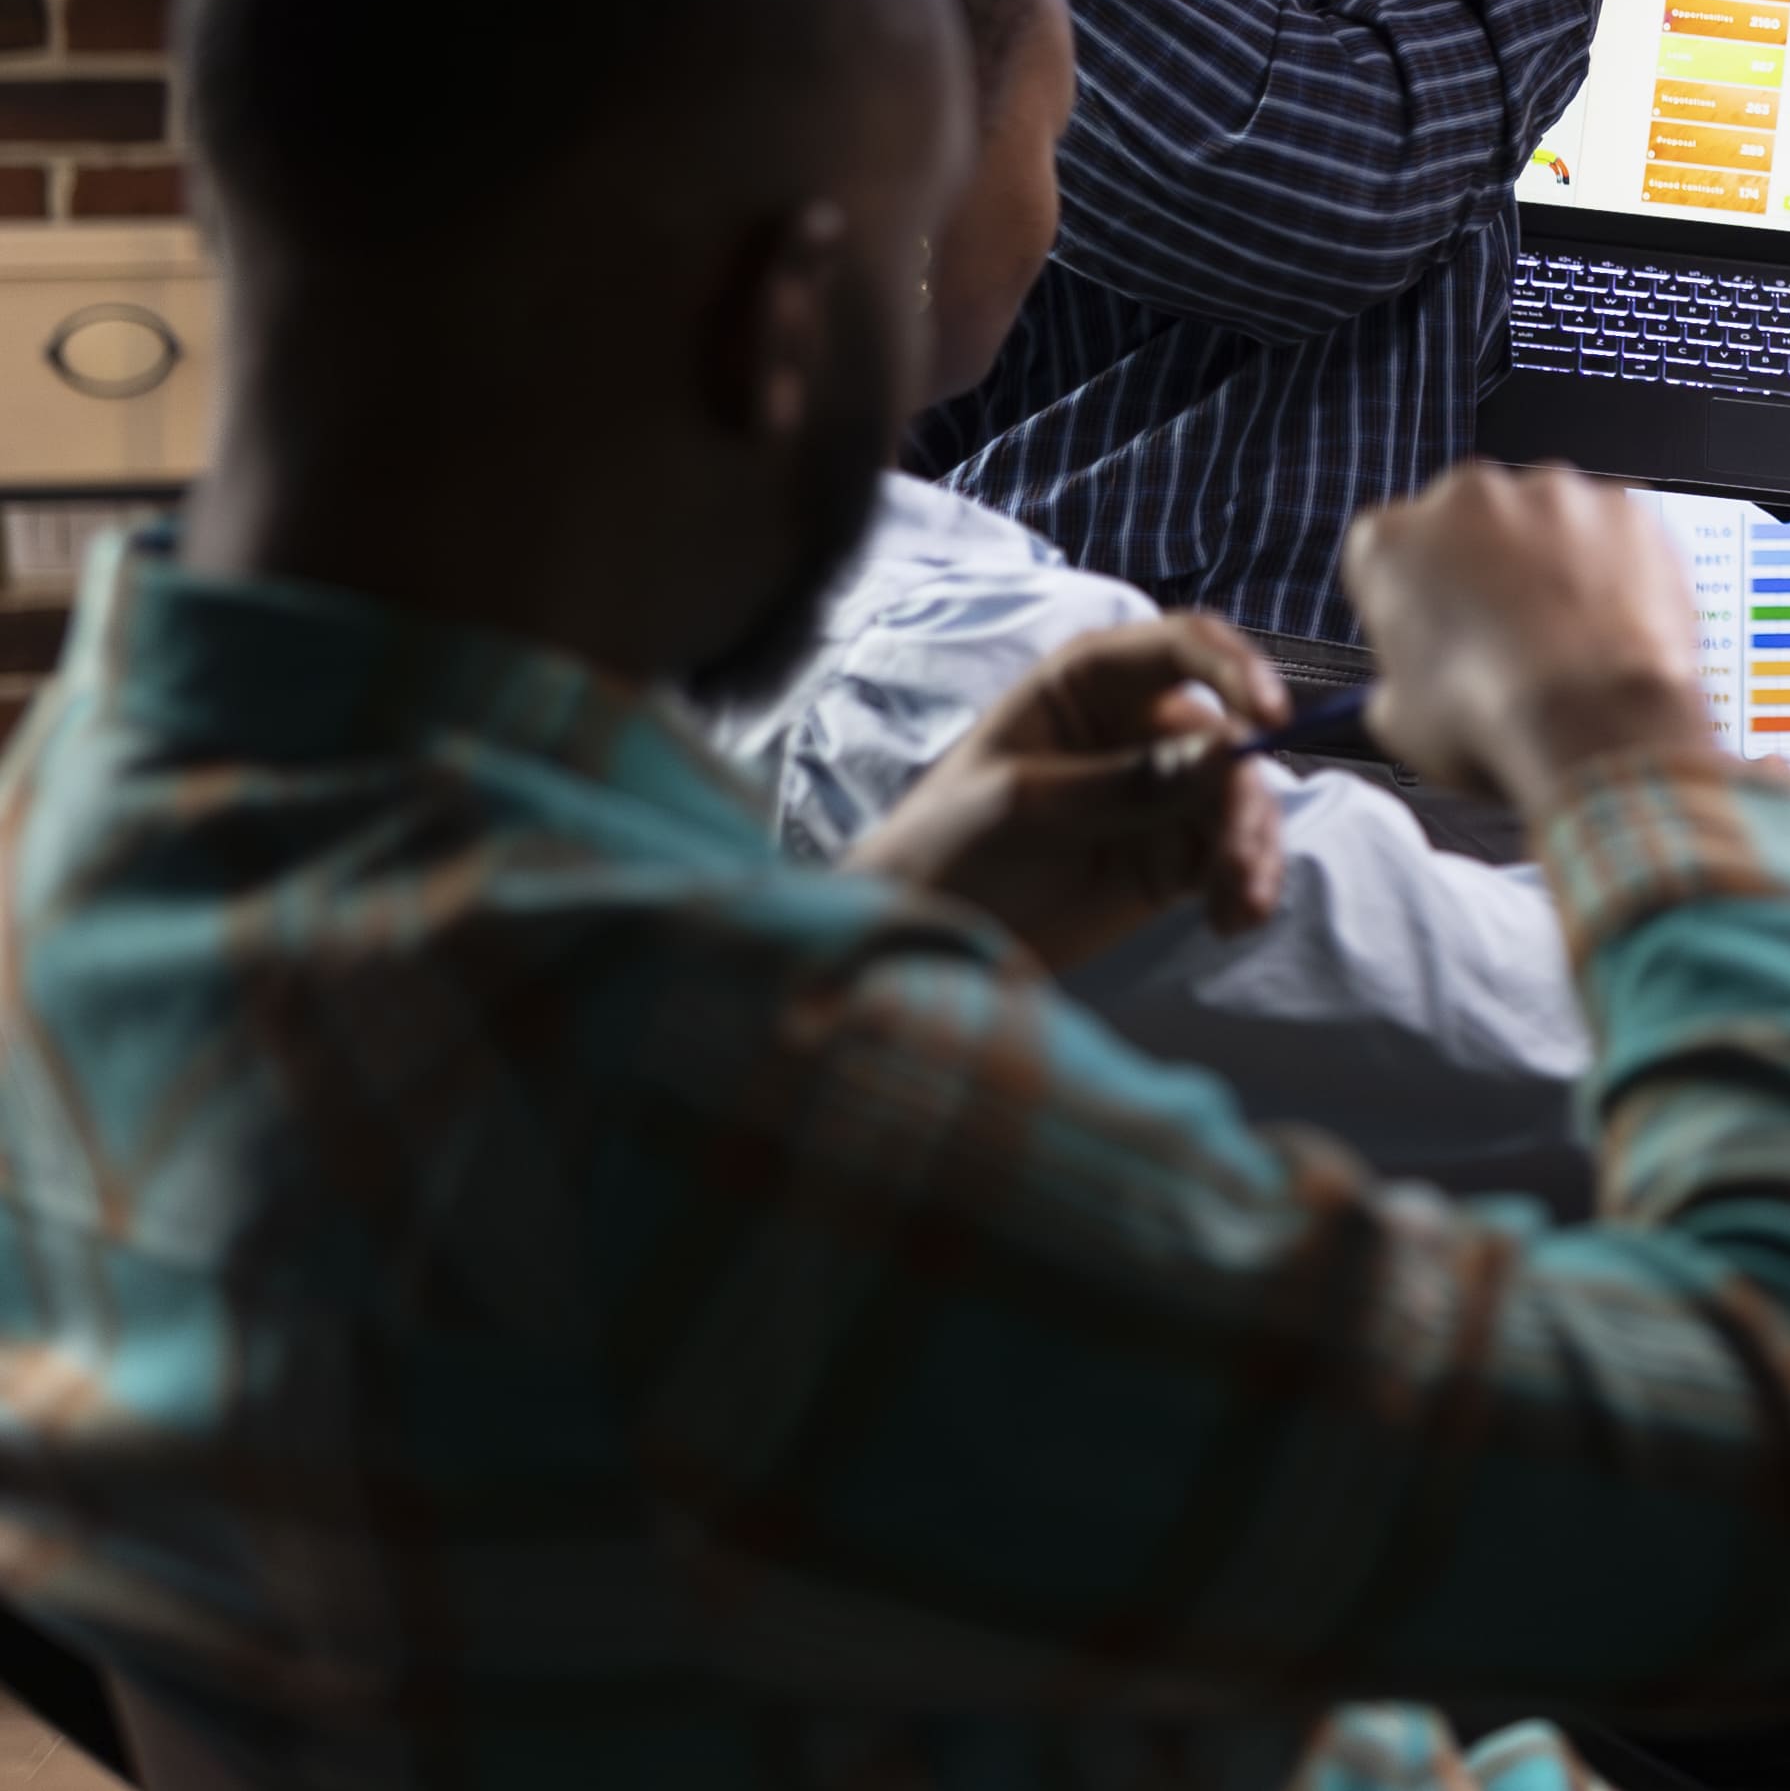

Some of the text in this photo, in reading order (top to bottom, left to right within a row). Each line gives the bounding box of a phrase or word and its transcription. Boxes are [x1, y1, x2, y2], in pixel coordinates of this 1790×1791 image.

[1671, 8, 1734, 24] Opportunities
[1656, 135, 1697, 148] Proposal
[1604, 297, 1617, 305] W
